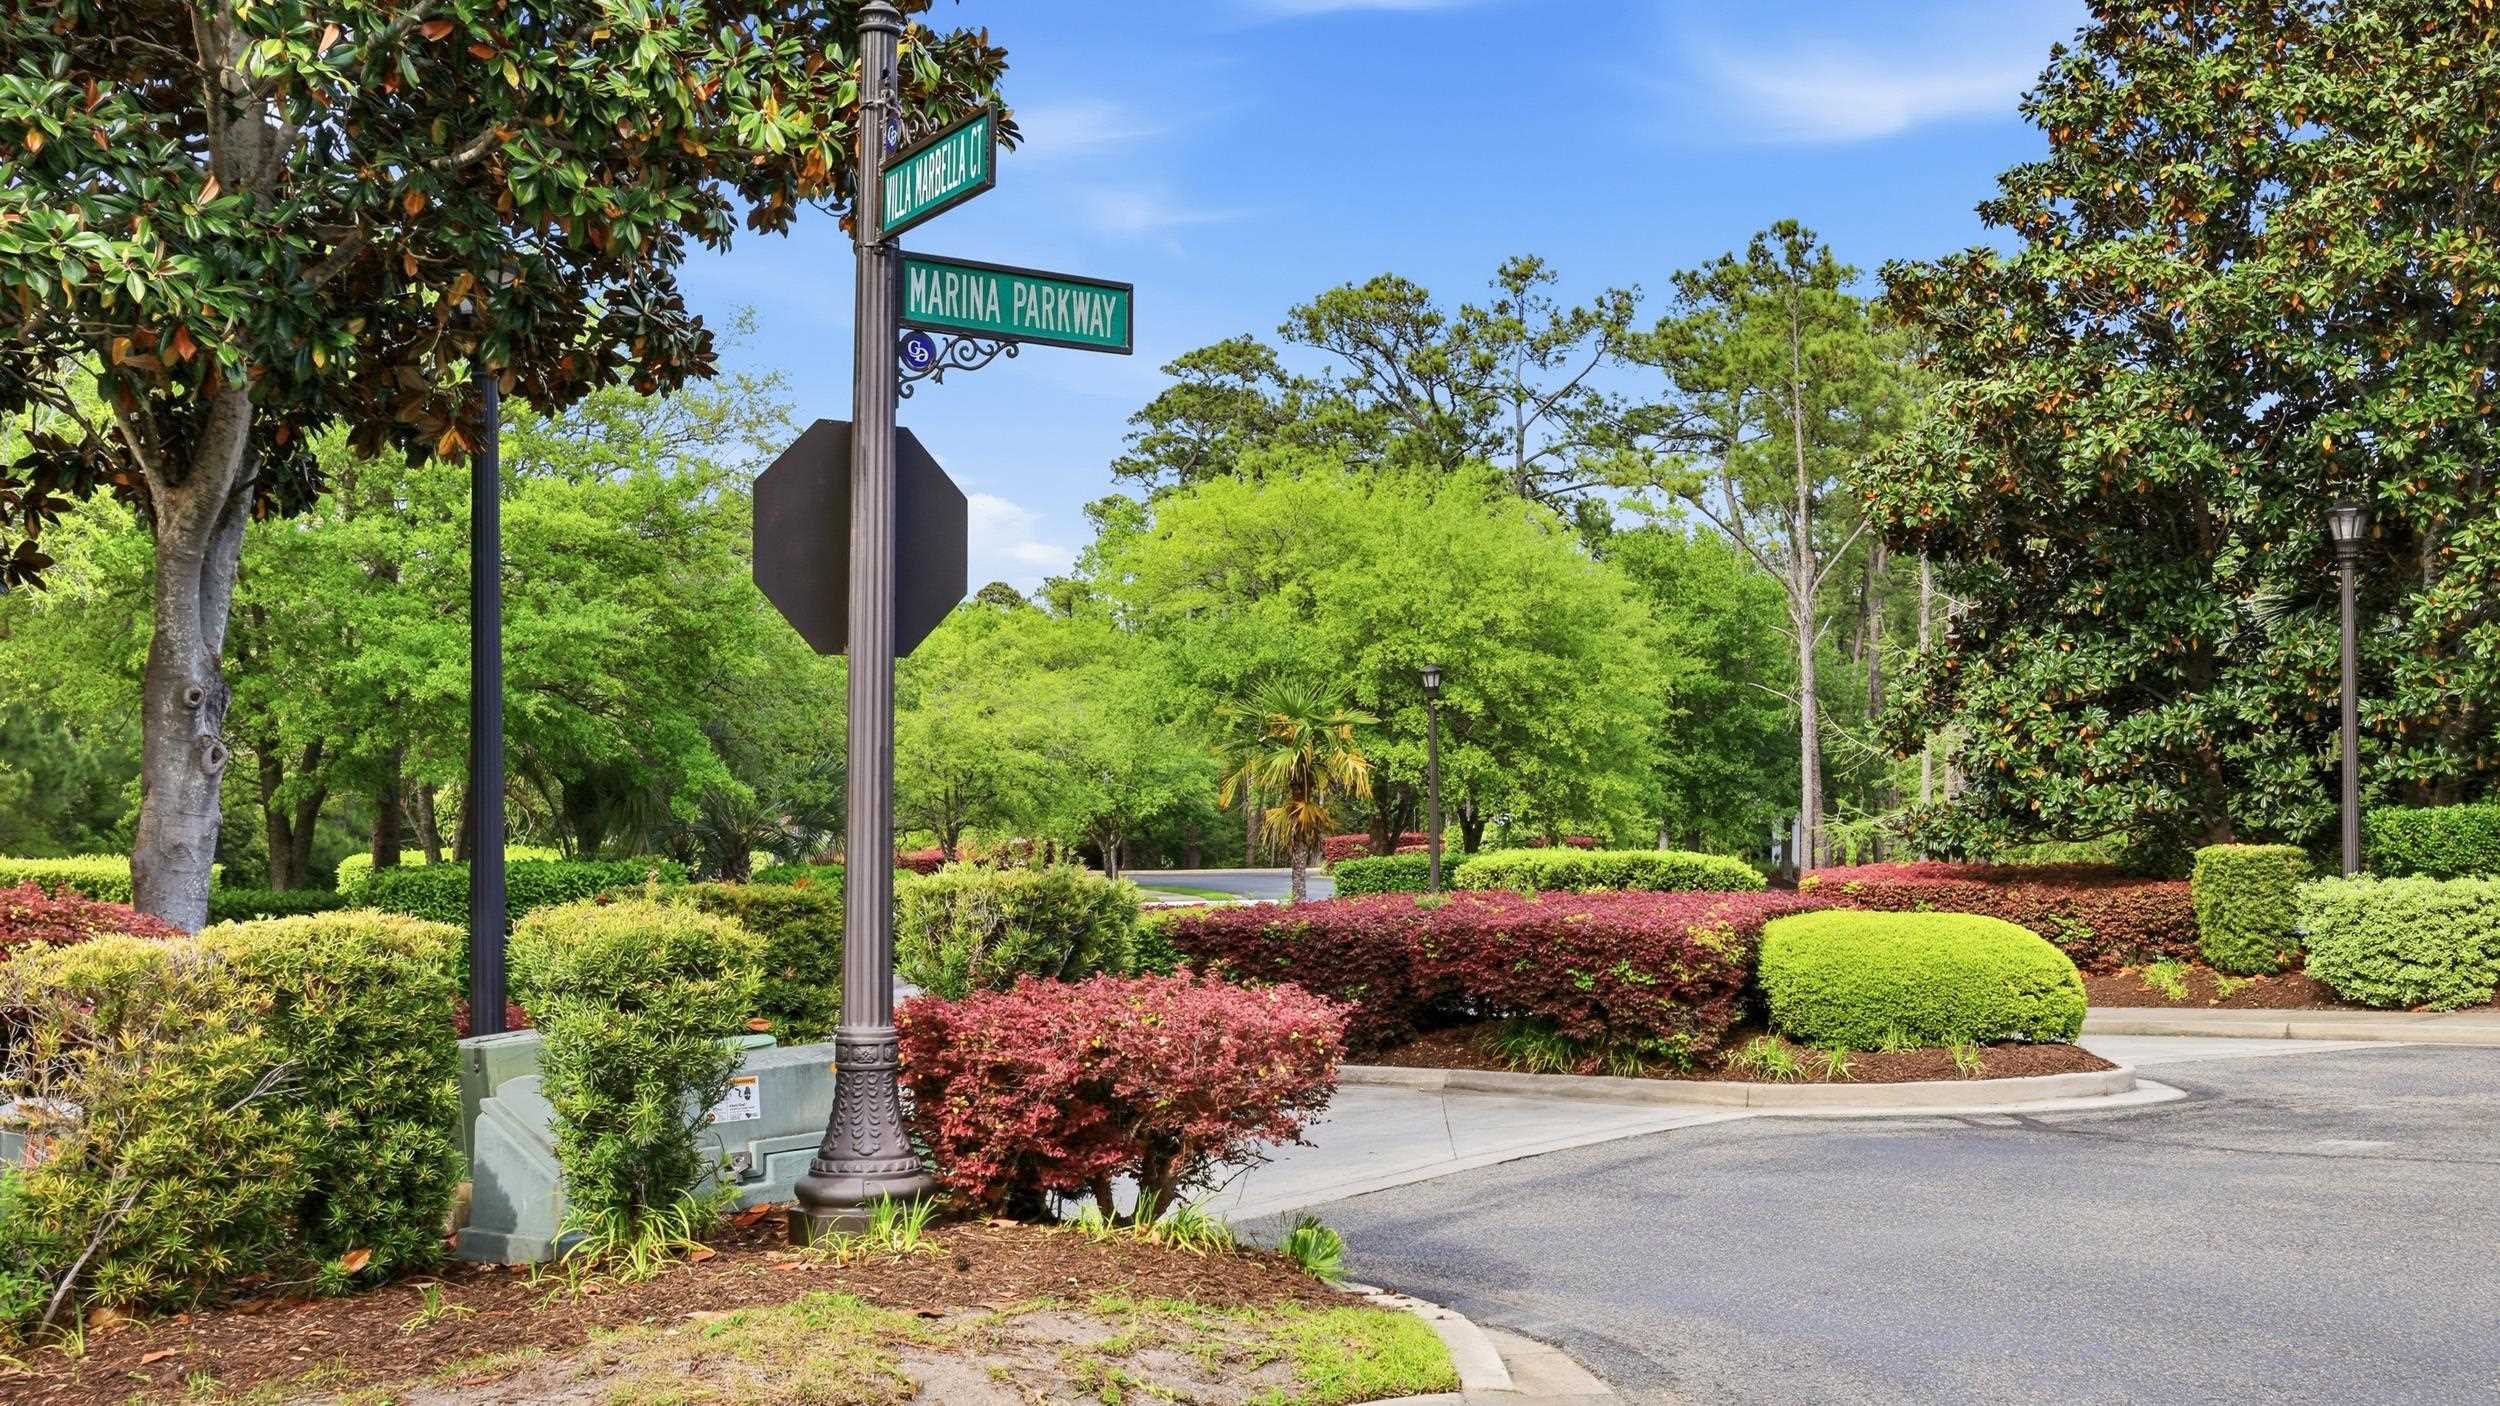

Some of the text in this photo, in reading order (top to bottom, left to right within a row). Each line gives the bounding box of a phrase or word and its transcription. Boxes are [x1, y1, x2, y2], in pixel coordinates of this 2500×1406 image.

[886, 124, 983, 223] VILLA MARBELLA CT
[910, 266, 1117, 338] MARINA PARKWAY
